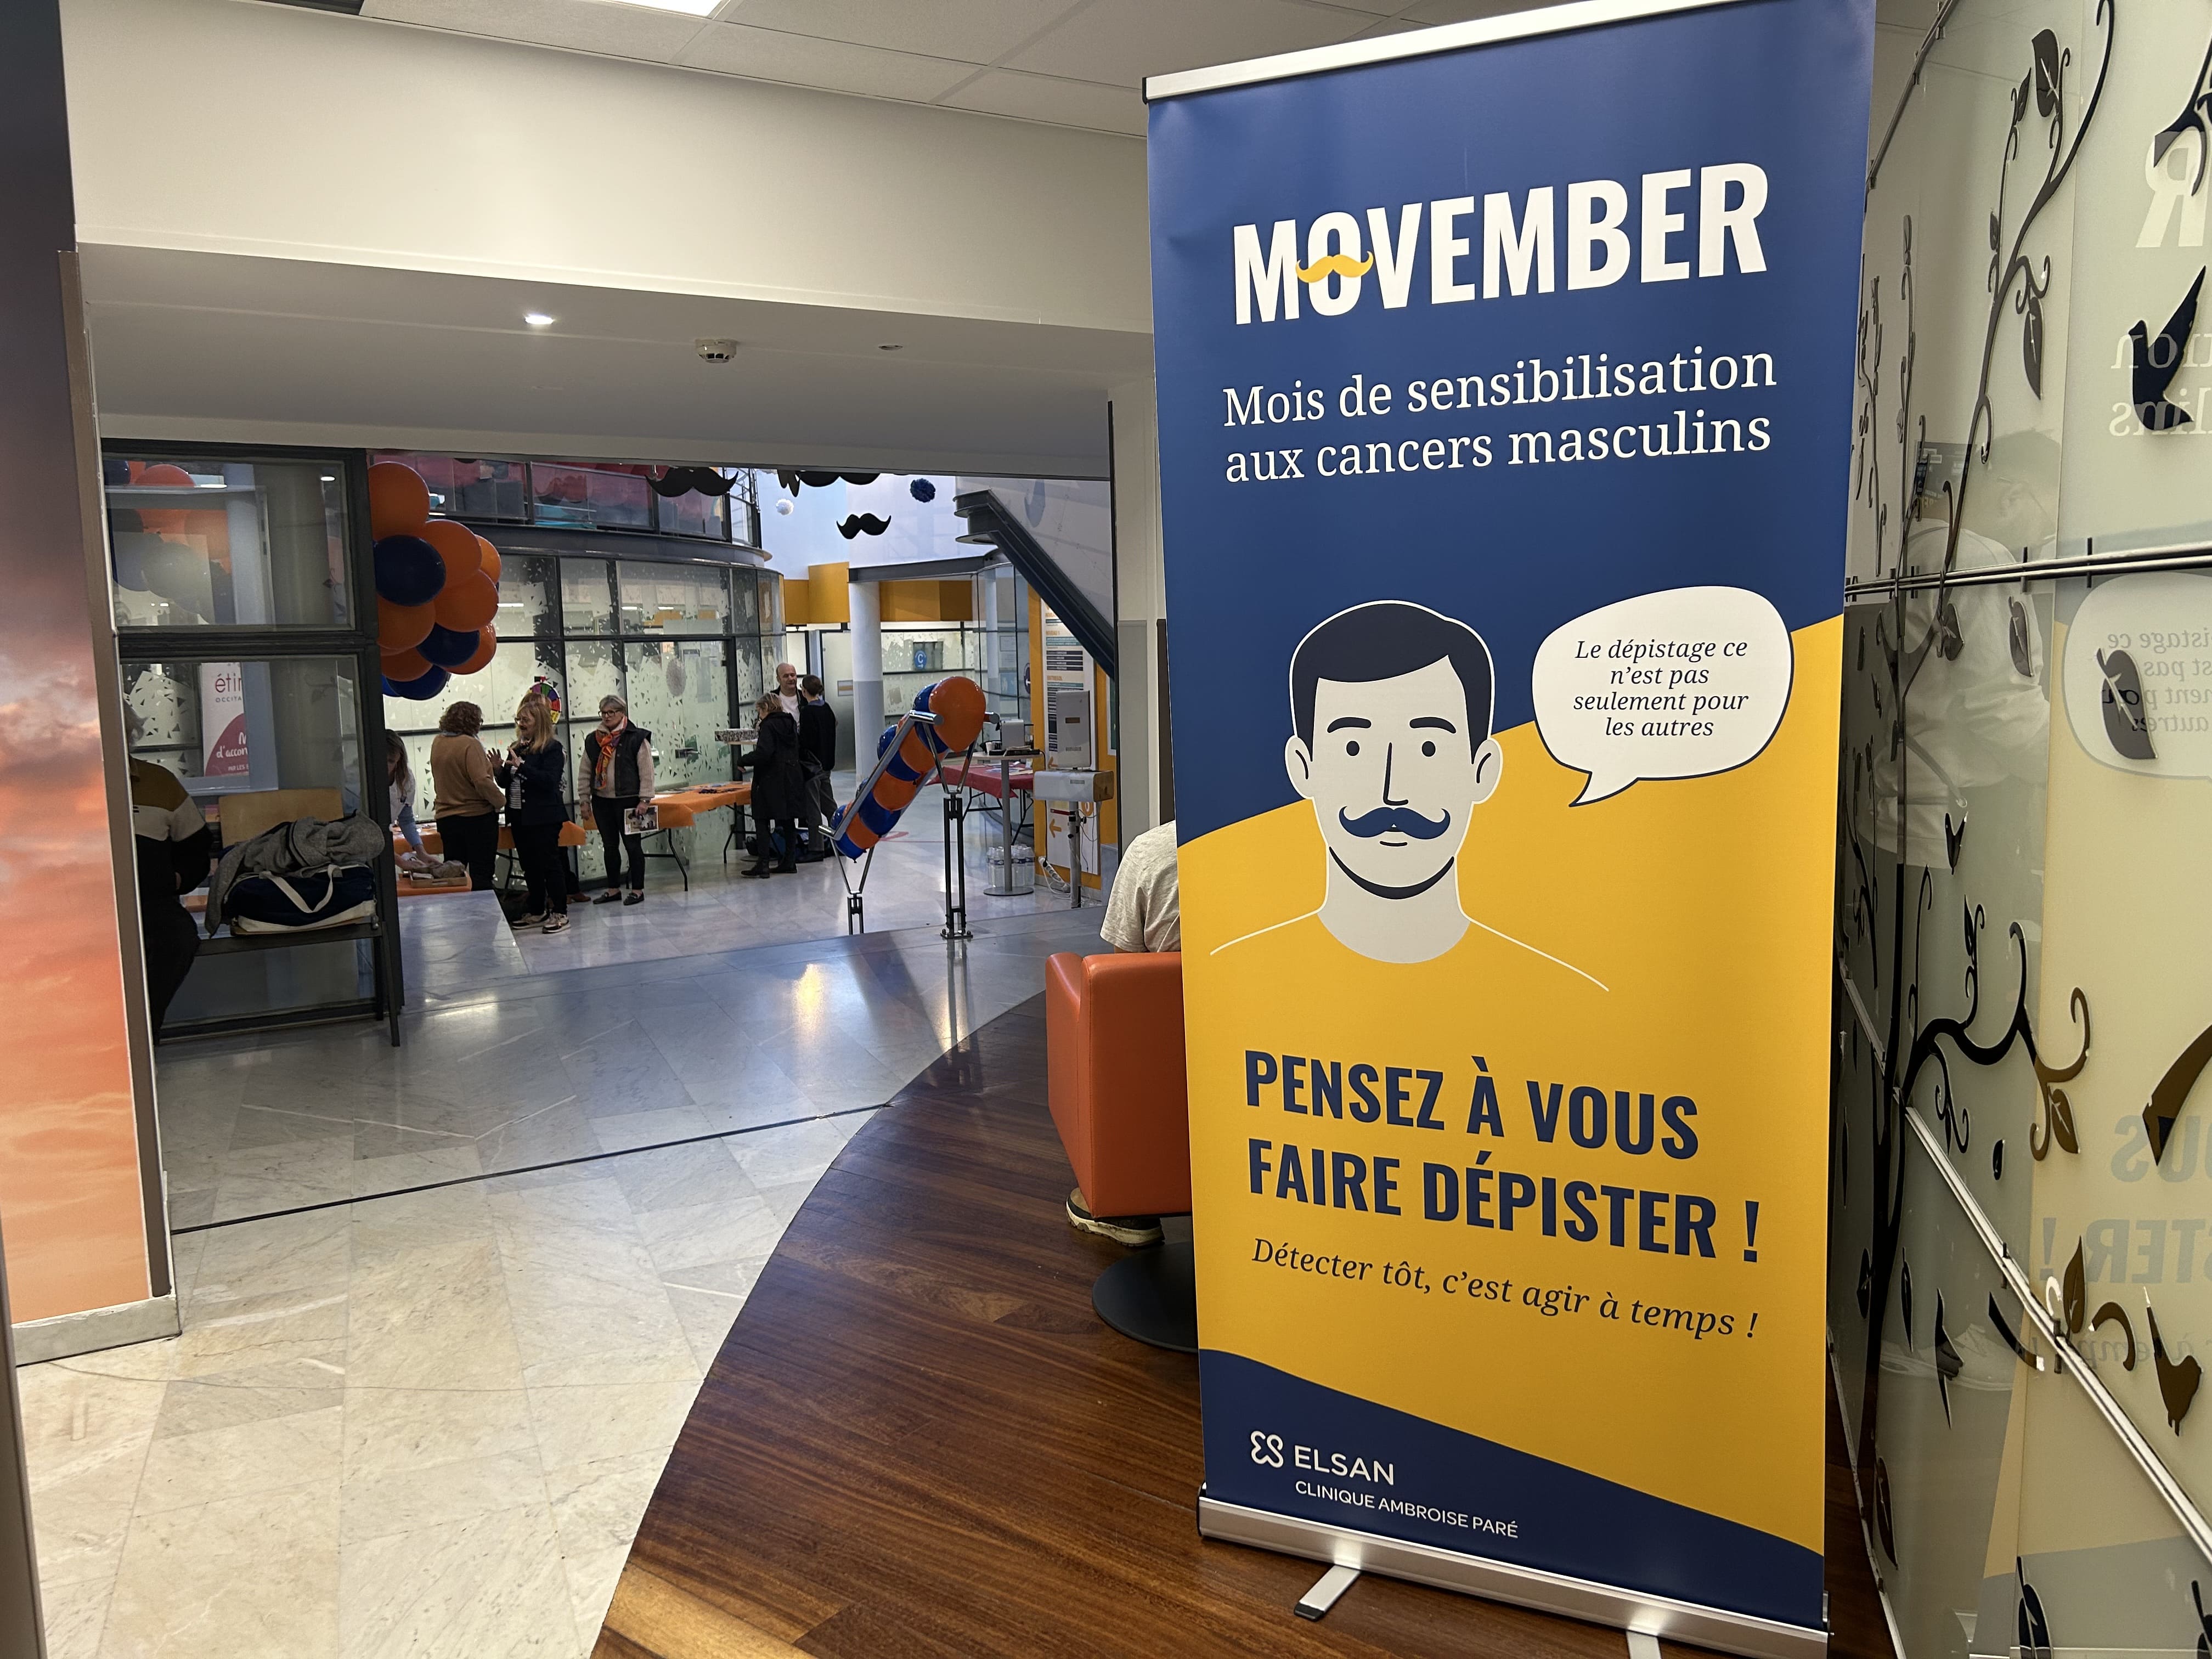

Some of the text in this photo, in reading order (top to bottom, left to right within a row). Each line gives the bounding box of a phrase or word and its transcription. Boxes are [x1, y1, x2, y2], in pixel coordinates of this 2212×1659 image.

[1233, 163, 1768, 325] MOVEMBER
[1222, 346, 1777, 427] Mois de sensibilisation
[1226, 409, 1770, 483] aux cancers masculins
[1575, 639, 1747, 664] Le dépistage ce
[1610, 667, 1709, 690] n’est pas
[1573, 691, 1749, 715] seulement pour
[1606, 717, 1714, 736] les autres
[1245, 1049, 1699, 1160] PENSEZ À VOUS
[1249, 1138, 1759, 1263] FAIRE DÉPISTER !
[1251, 1238, 1758, 1340] Détecter tôt, c’est agir à temps !
[1295, 1445, 1394, 1486] ELSAN
[1295, 1481, 1518, 1538] CLINIQUE AMBROISE PARÉ
